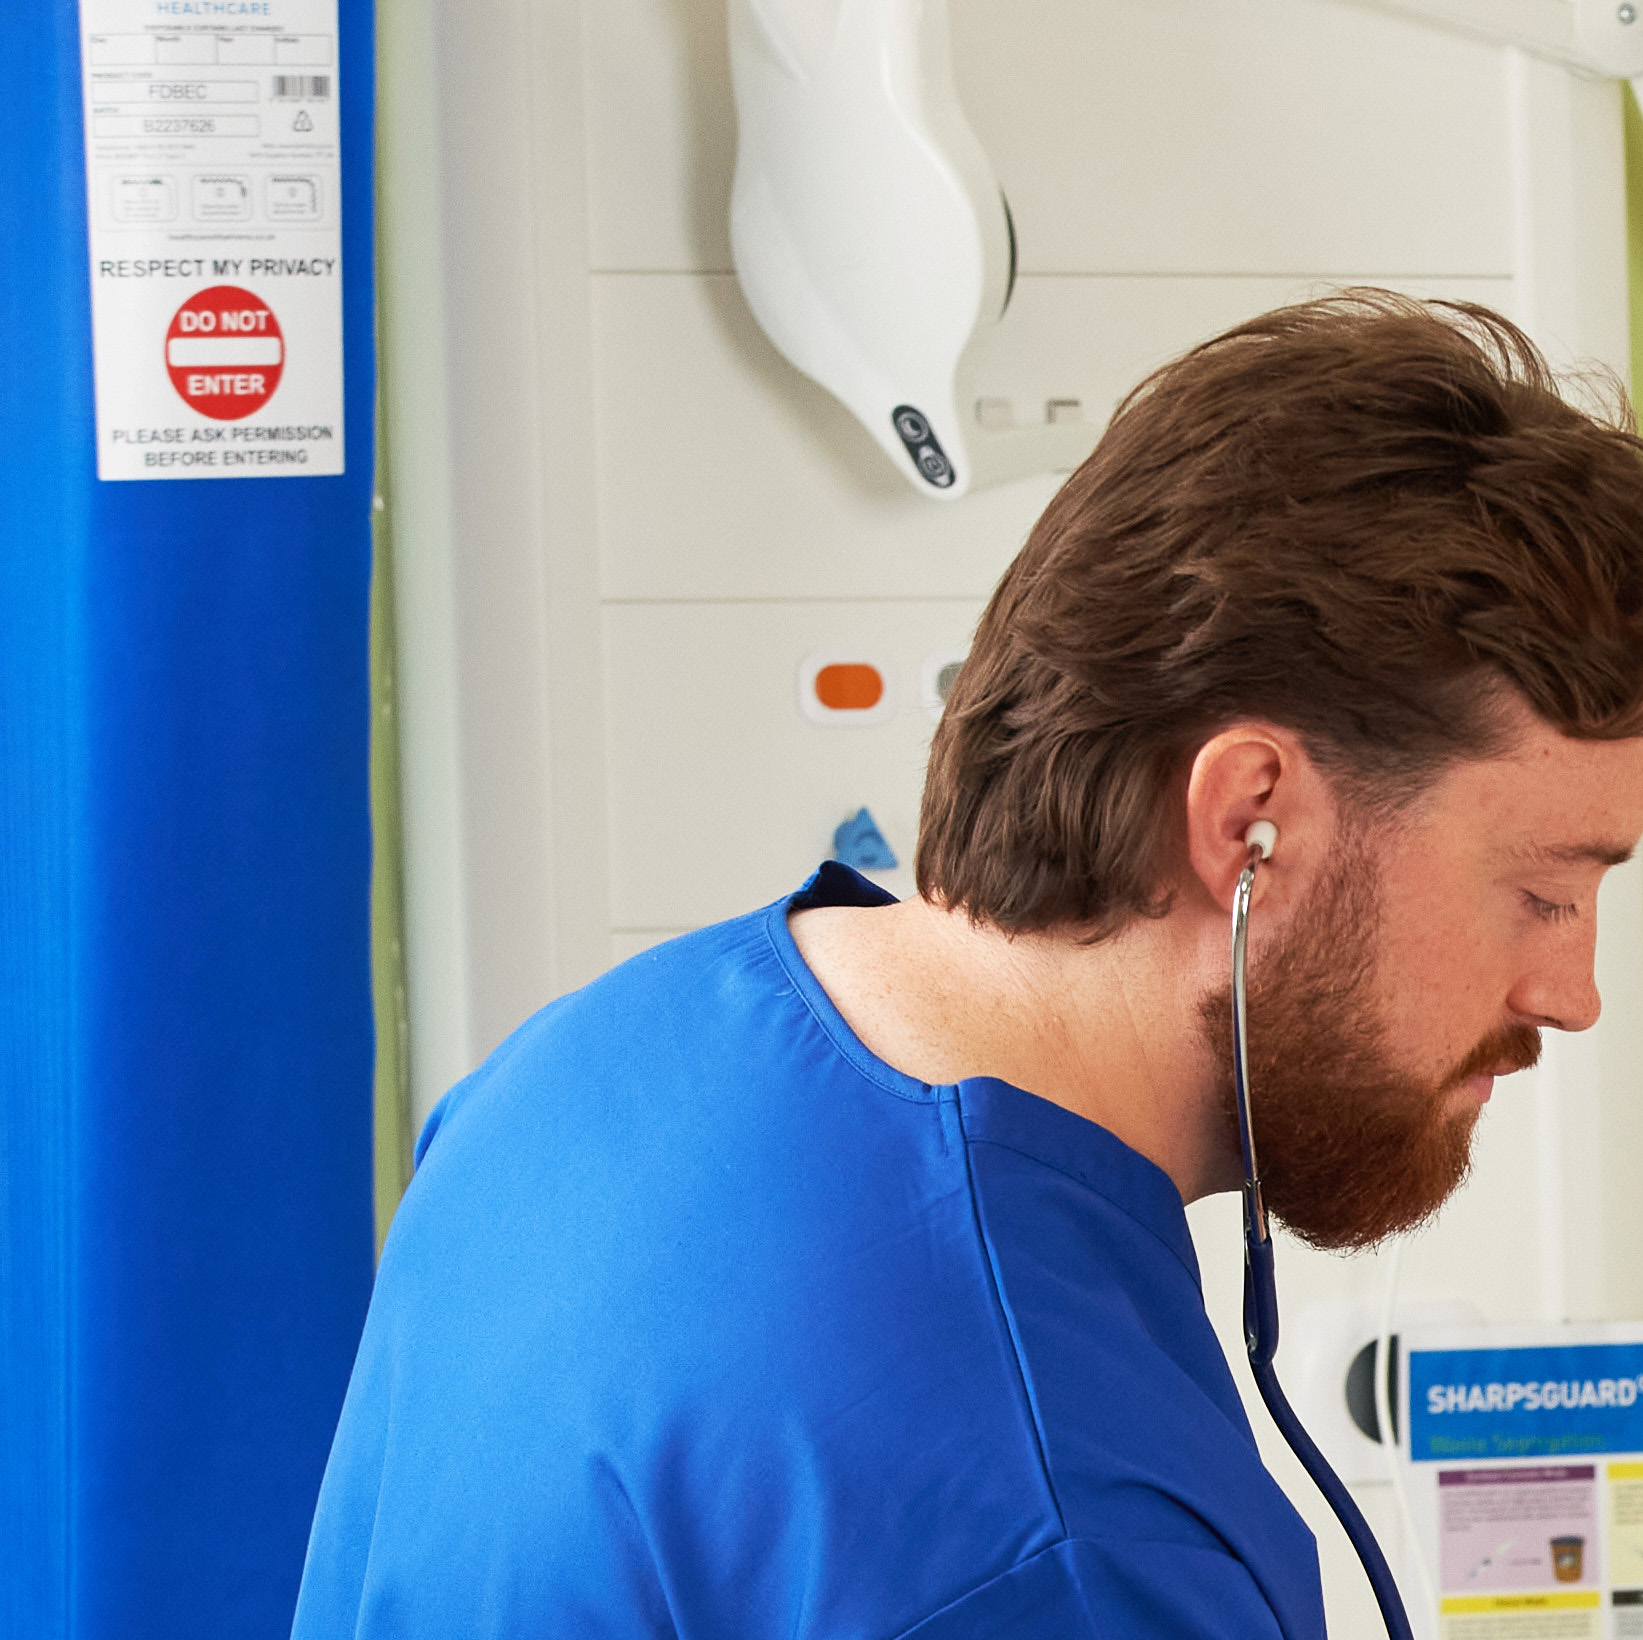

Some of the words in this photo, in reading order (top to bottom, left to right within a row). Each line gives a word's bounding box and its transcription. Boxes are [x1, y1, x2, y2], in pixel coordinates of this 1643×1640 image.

[157, 2, 272, 16] HEALTHCARE
[100, 259, 204, 278] RESPECT
[213, 258, 248, 277] MY
[250, 258, 336, 277] PRIVACY
[179, 310, 216, 332] DO
[221, 309, 269, 331] NOT
[187, 374, 266, 396] ENTER
[112, 428, 185, 444] PLEASE
[191, 427, 225, 442] ASK
[231, 425, 333, 441] PERMISSION
[144, 451, 218, 467] BEFORE
[224, 449, 308, 466] ENTERING
